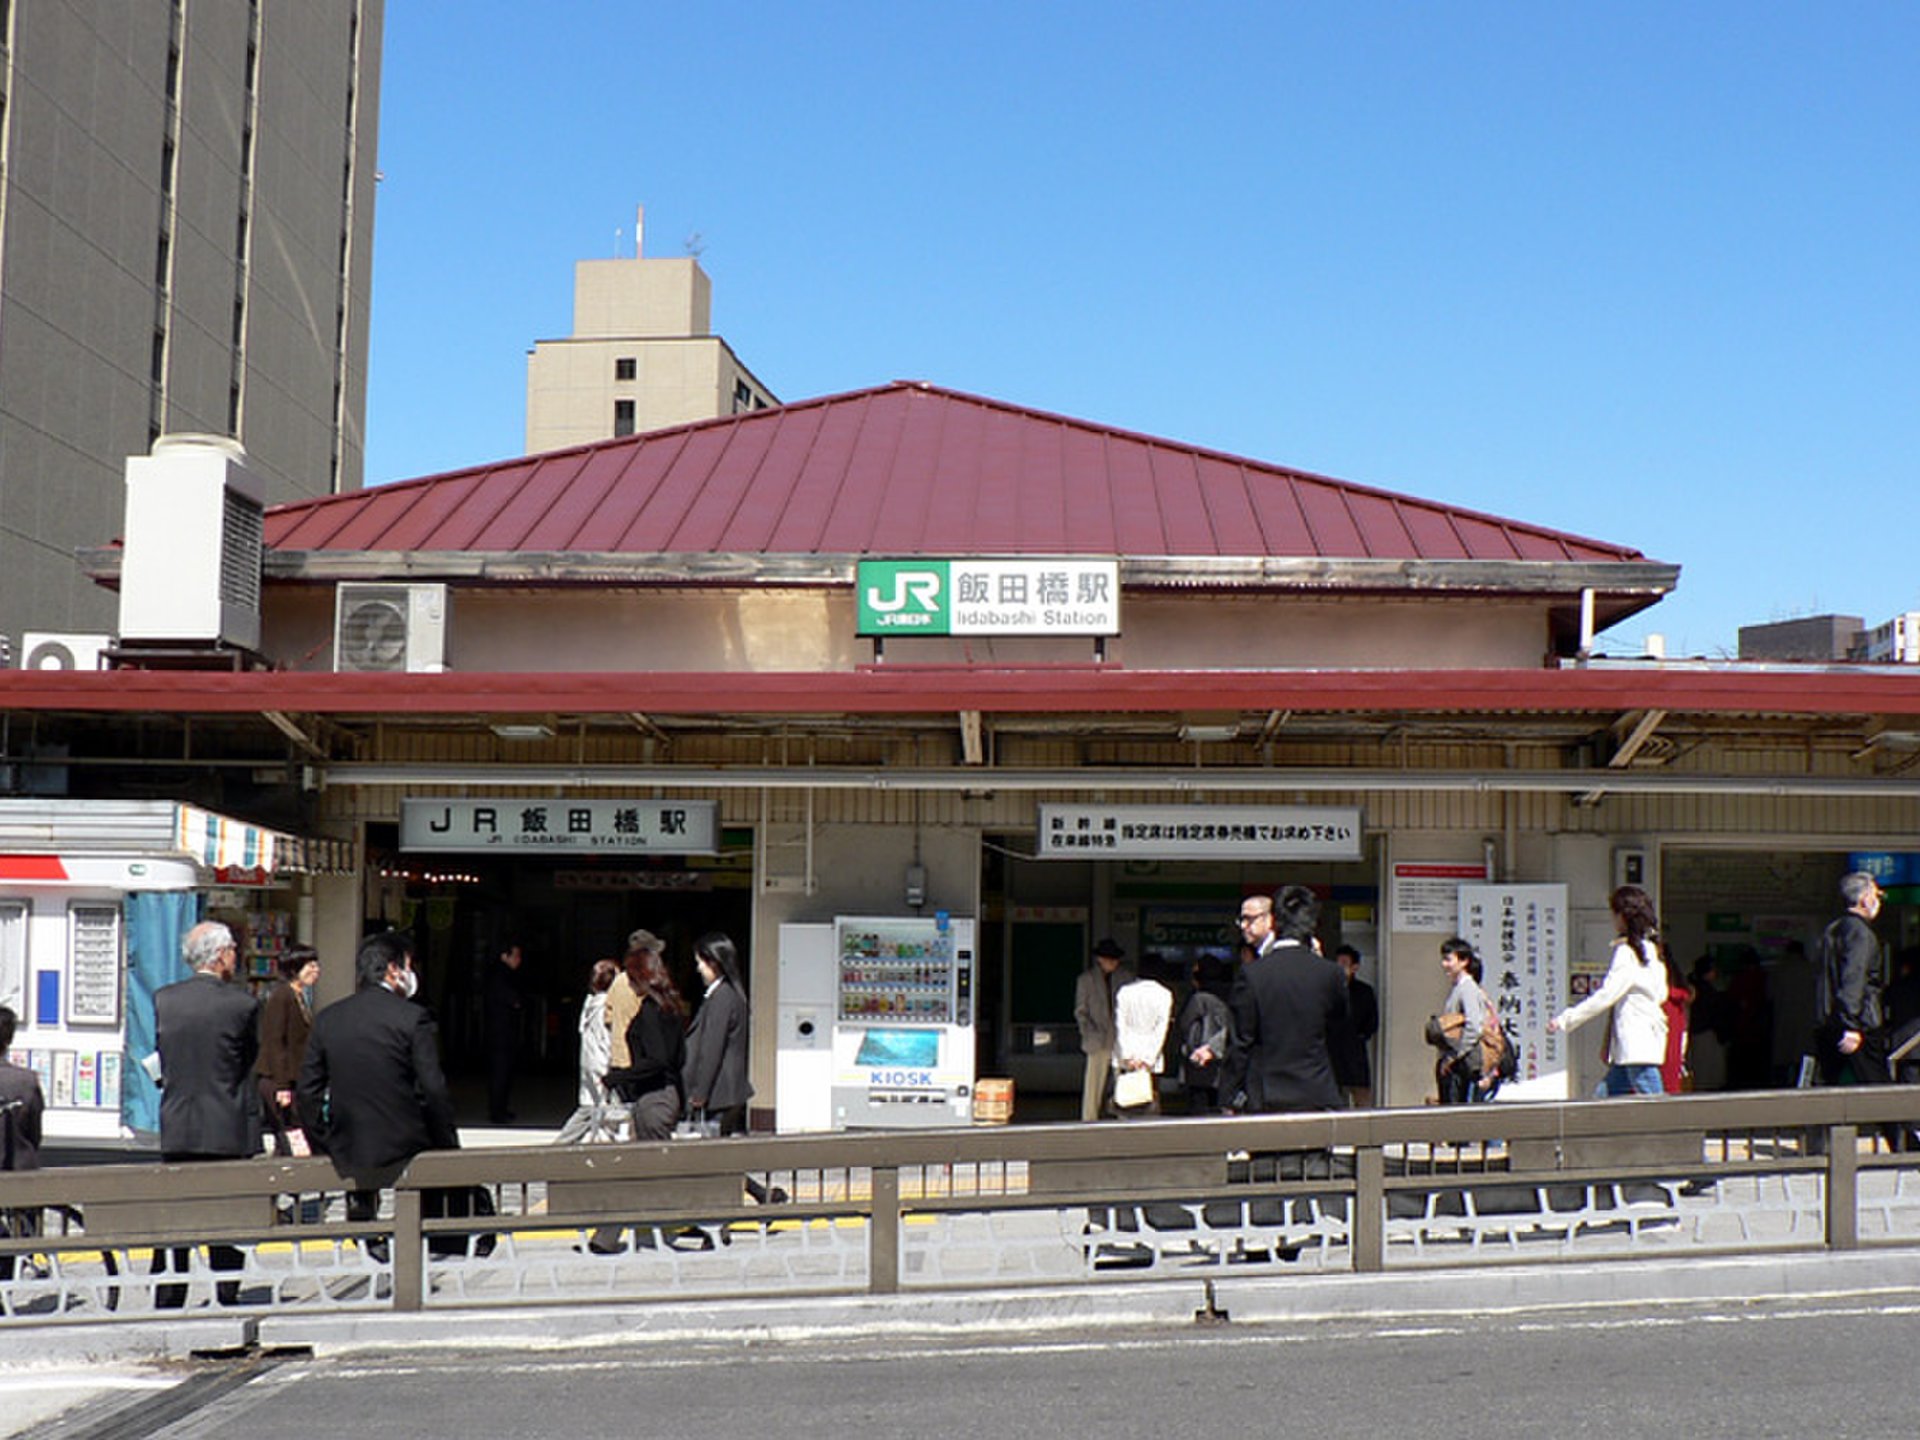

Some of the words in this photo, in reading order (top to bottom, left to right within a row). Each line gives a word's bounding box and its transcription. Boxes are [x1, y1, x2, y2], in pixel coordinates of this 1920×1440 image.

[867, 571, 940, 611] JR
[957, 572, 1109, 605] 飯田橋駅
[957, 611, 1036, 626] Iidabashi
[1043, 611, 1108, 626] Station
[590, 836, 647, 846] STATION
[870, 1072, 933, 1086] KIOSK
